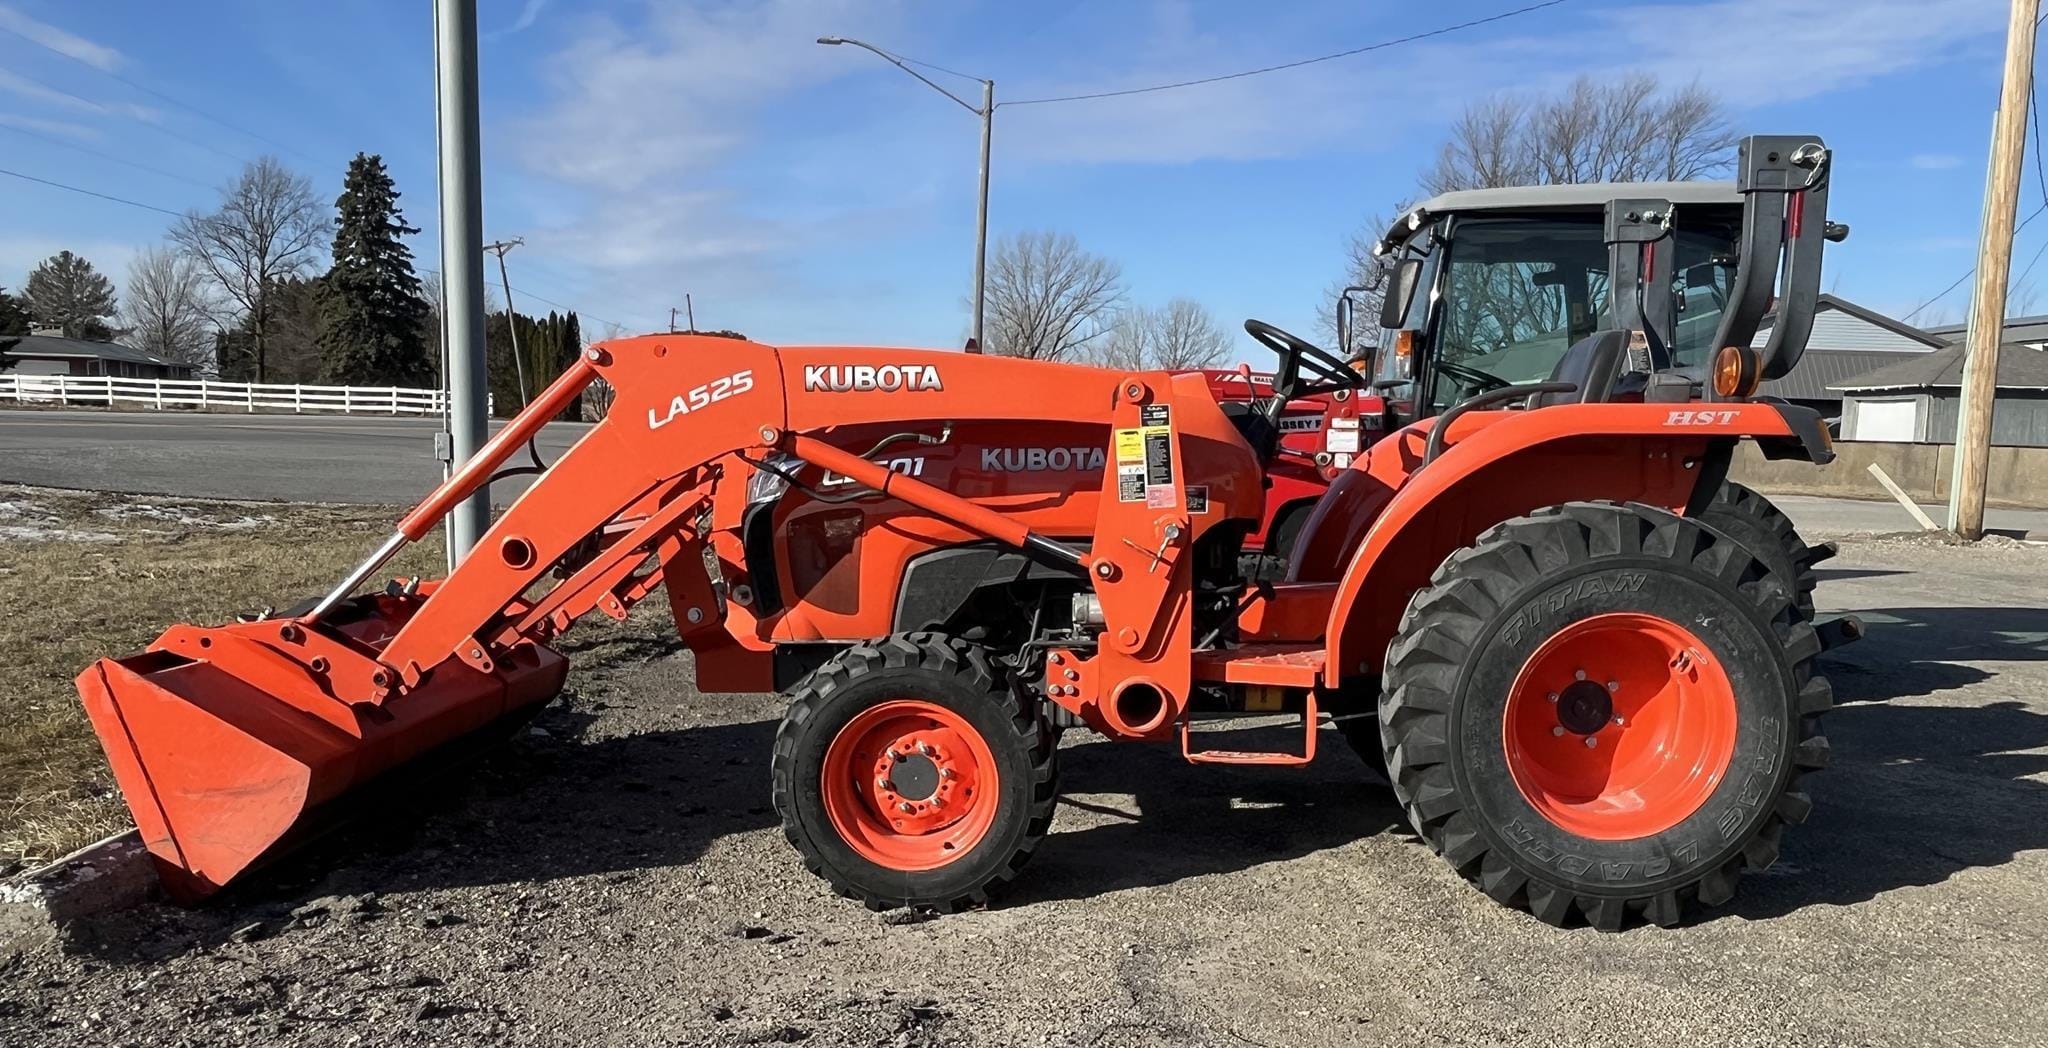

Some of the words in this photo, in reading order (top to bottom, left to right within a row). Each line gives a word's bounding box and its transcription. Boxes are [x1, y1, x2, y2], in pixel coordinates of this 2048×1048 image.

[648, 369, 754, 430] LA525
[804, 364, 944, 393] KUBOTA
[1662, 410, 1740, 426] HST
[981, 446, 1105, 472] KUBOTA
[1503, 573, 1648, 647] TITAN
[1716, 715, 1782, 841] TRAC
[1503, 818, 1700, 880] LOADER
